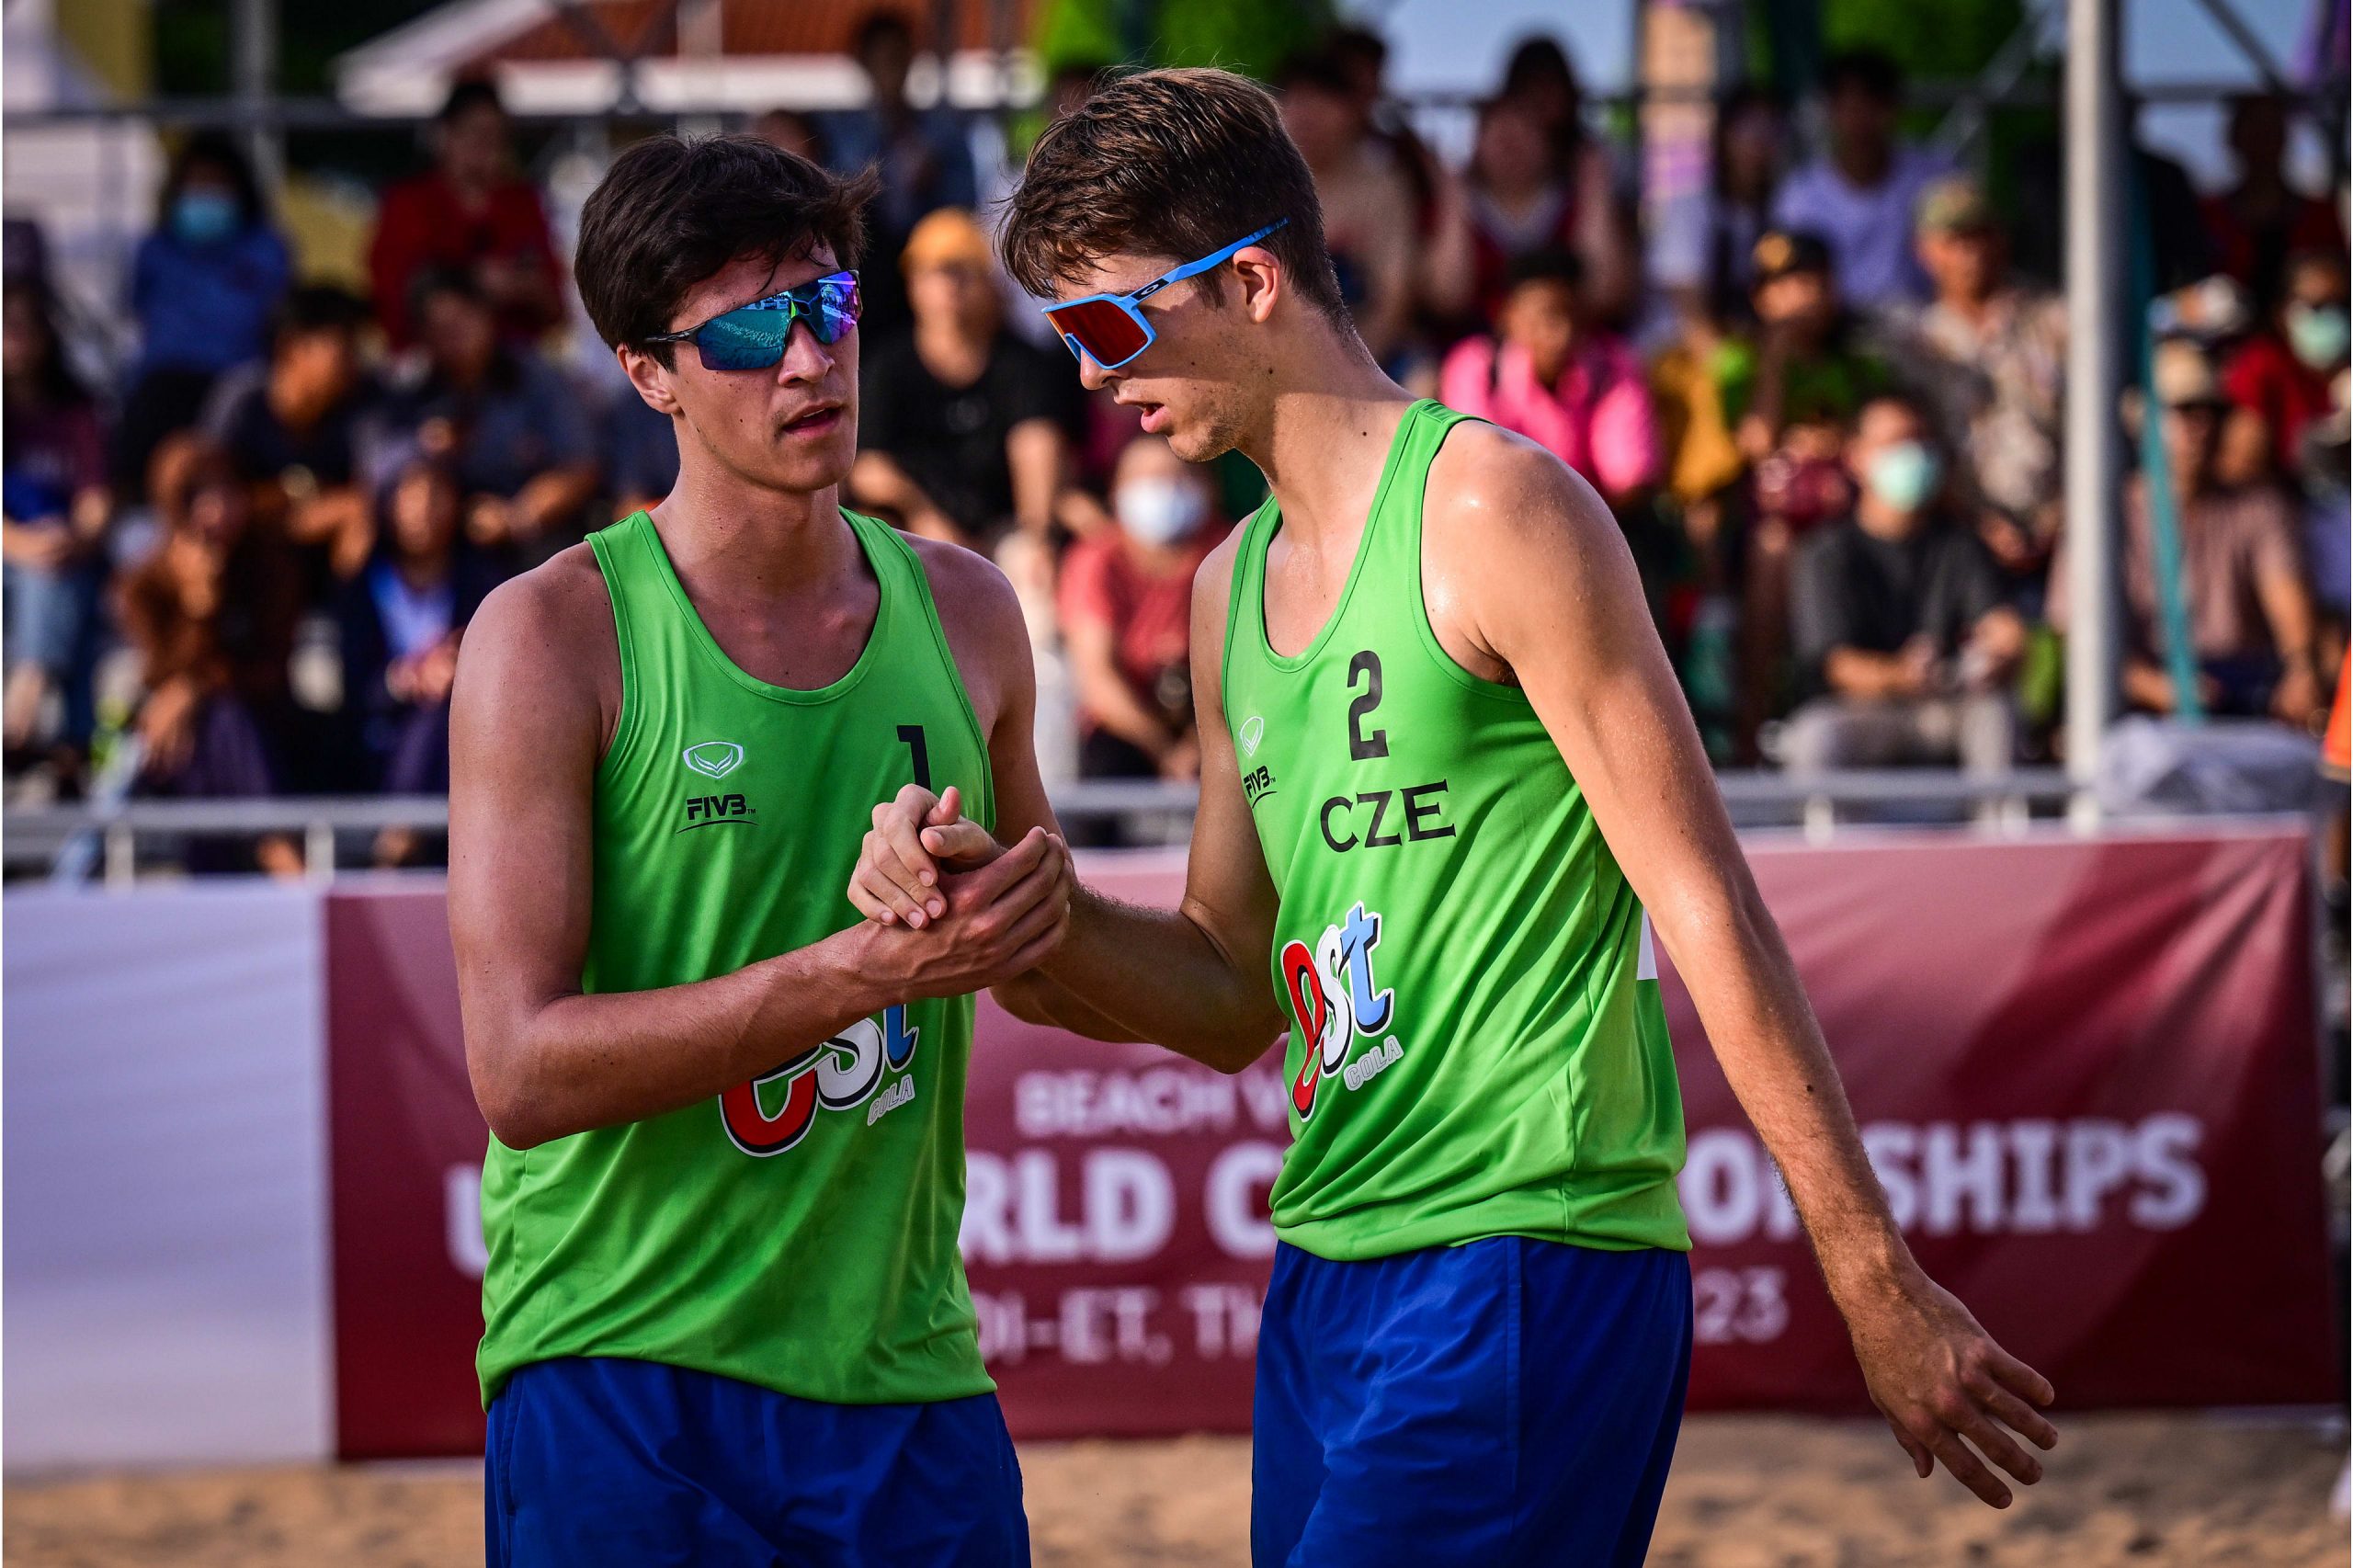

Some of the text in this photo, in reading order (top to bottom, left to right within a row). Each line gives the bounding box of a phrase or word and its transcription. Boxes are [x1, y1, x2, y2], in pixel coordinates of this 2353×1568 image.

[1347, 650, 1390, 761] 2
[896, 724, 931, 793] 1
[1320, 778, 1456, 853] CZE
[1280, 900, 1394, 1123] est
[1343, 1034, 1404, 1092] COLA
[867, 1074, 915, 1127] COLA
[1016, 1069, 1237, 1138] BEACH
[959, 1147, 1176, 1263] RLD
